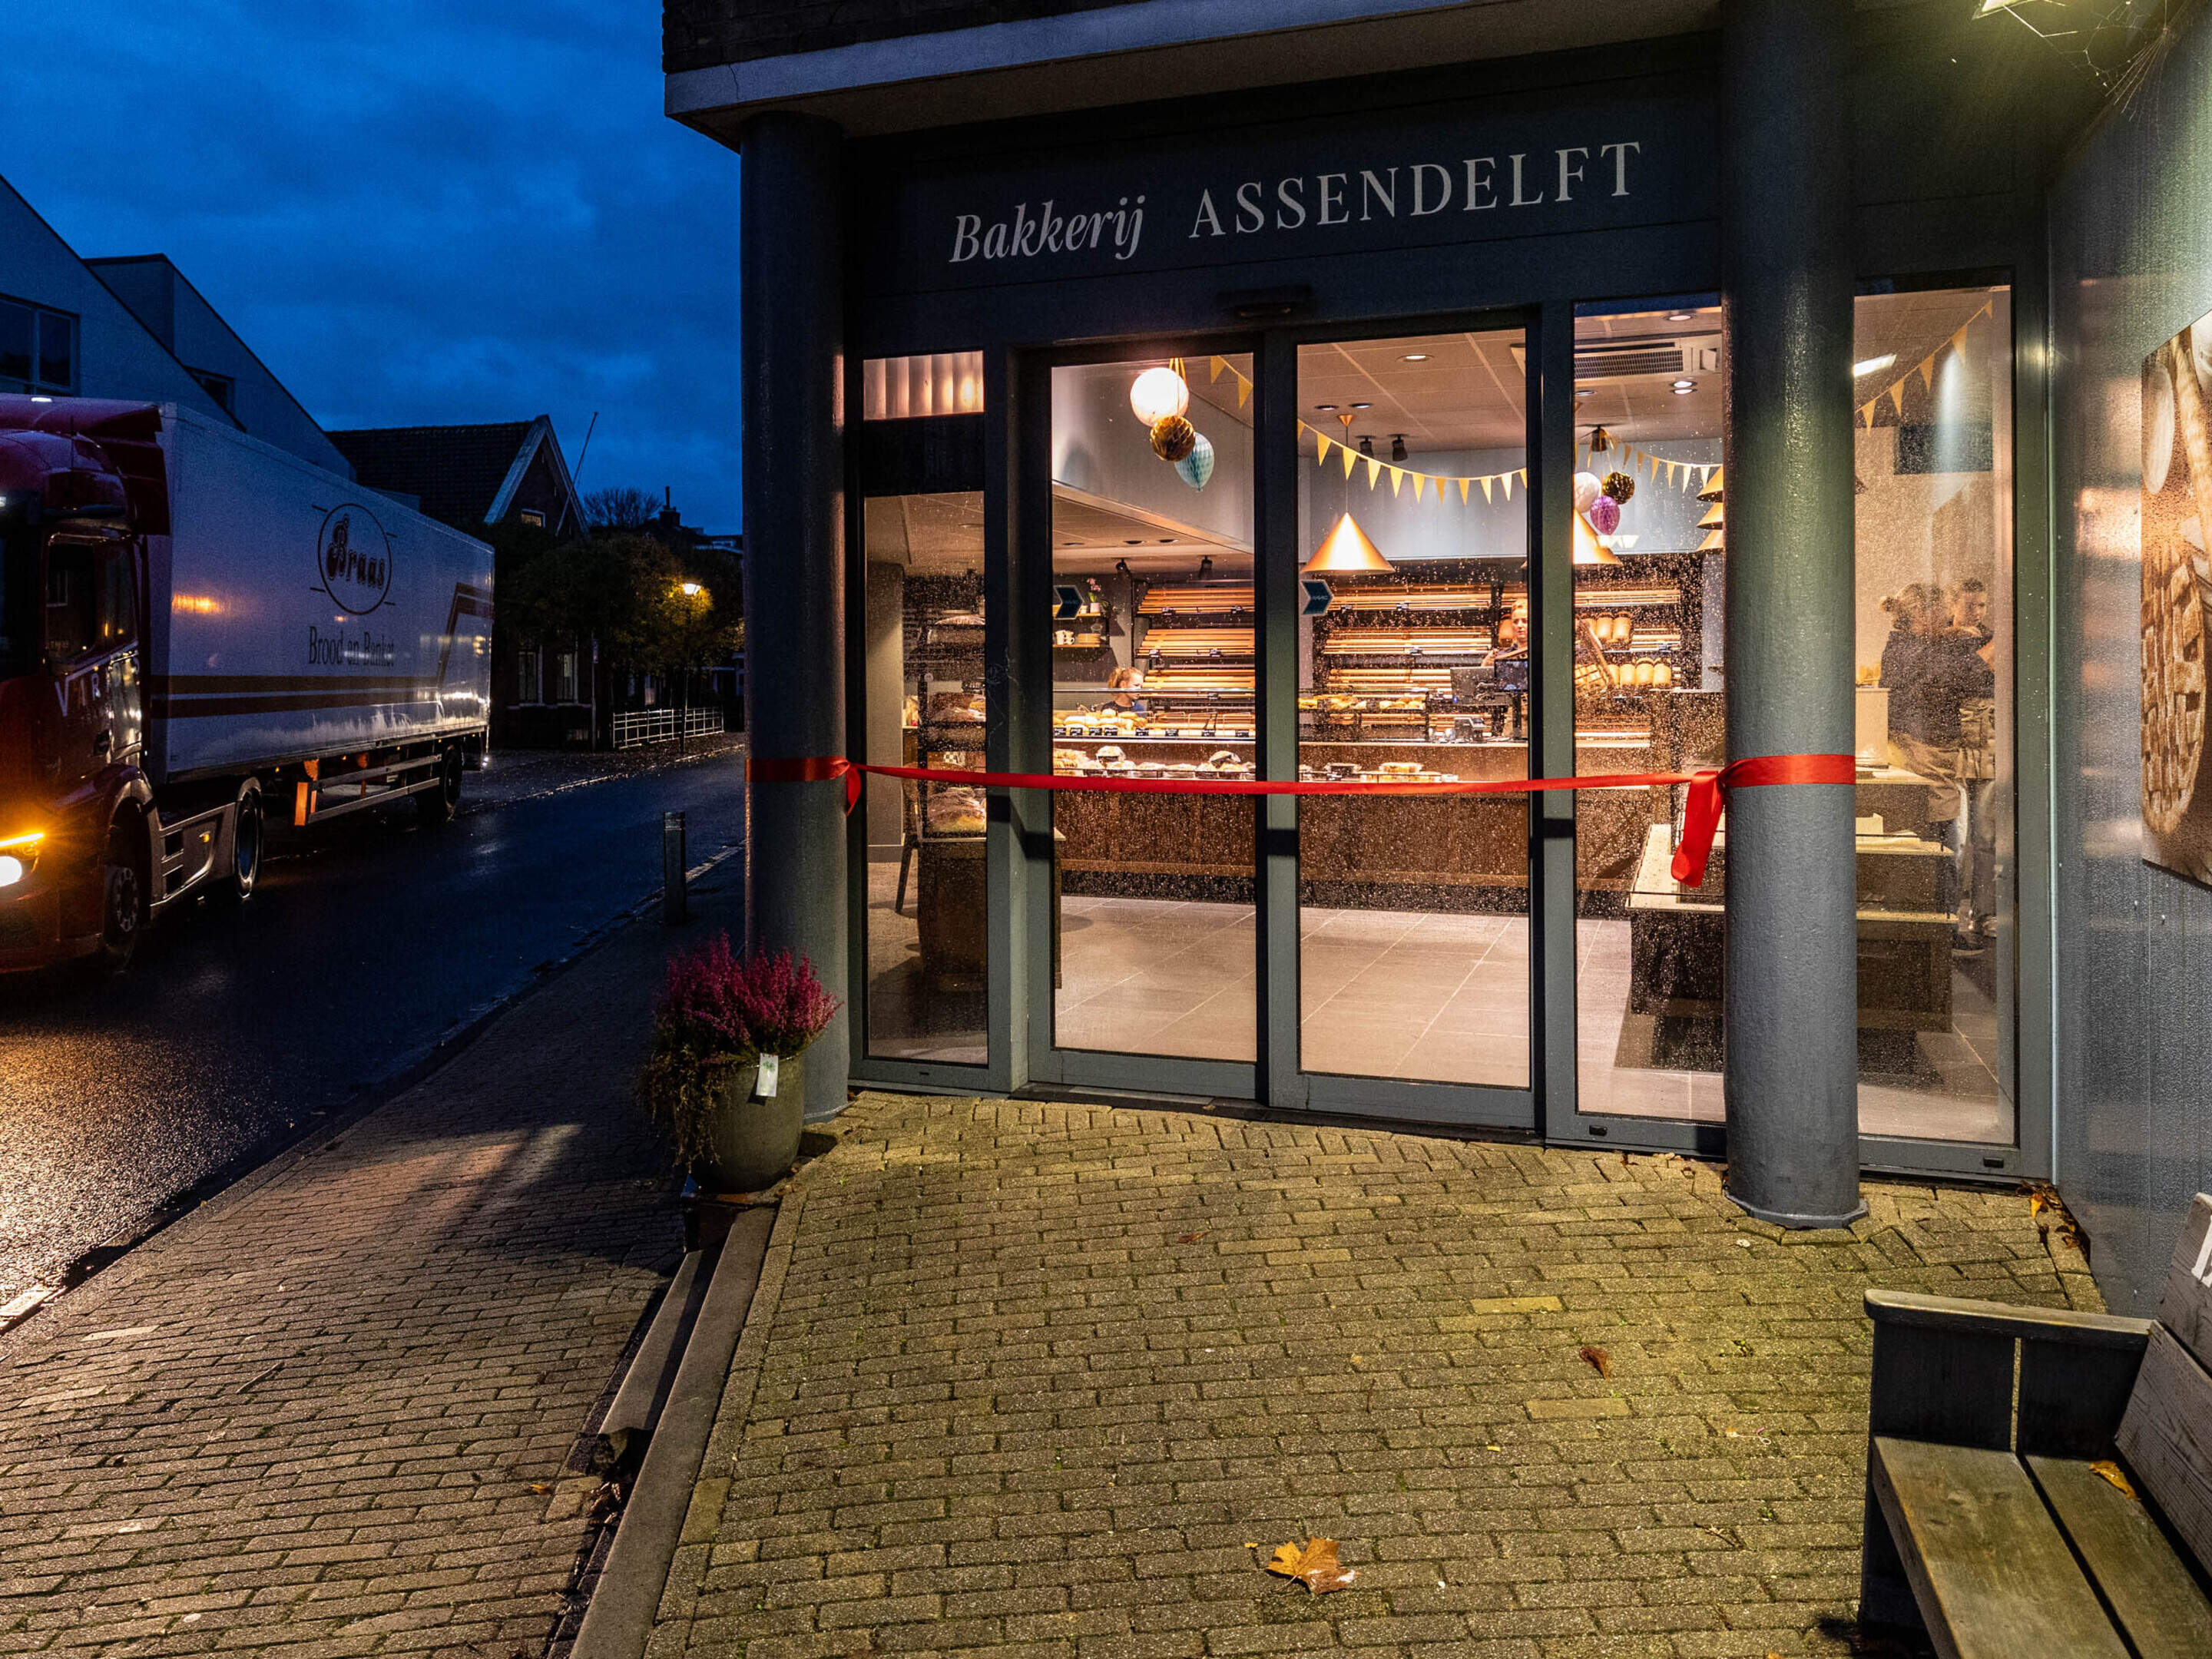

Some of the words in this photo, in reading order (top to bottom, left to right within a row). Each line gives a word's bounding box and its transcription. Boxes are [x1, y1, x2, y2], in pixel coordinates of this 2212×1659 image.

[949, 195, 1145, 263] Bakkerij
[1189, 141, 1640, 238] ASSENDELFT
[309, 626, 344, 665] Brood
[348, 641, 359, 666] en
[363, 631, 394, 667] Banket
